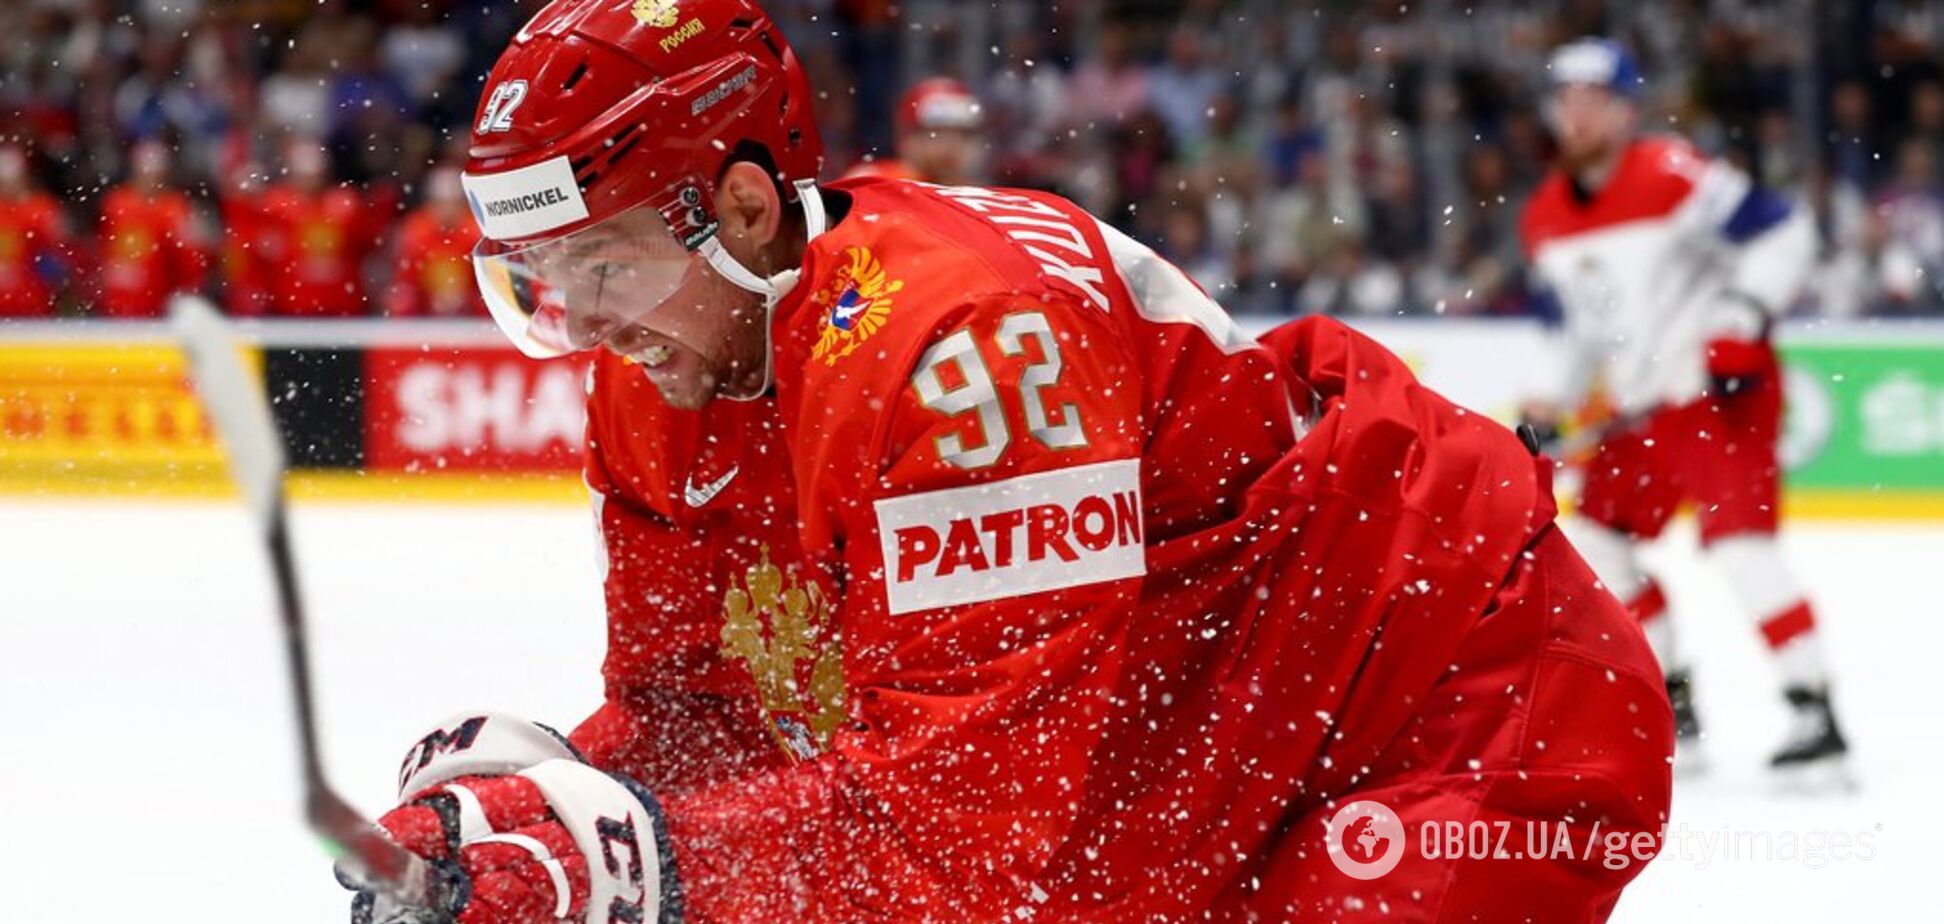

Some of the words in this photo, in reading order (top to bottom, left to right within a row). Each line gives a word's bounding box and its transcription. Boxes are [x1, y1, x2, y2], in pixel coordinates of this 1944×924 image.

[659, 17, 706, 54] РОССИЯ
[477, 79, 529, 135] 92
[485, 186, 569, 217] NORNICKEL
[912, 310, 1089, 470] 92
[893, 490, 1142, 583] PATRON
